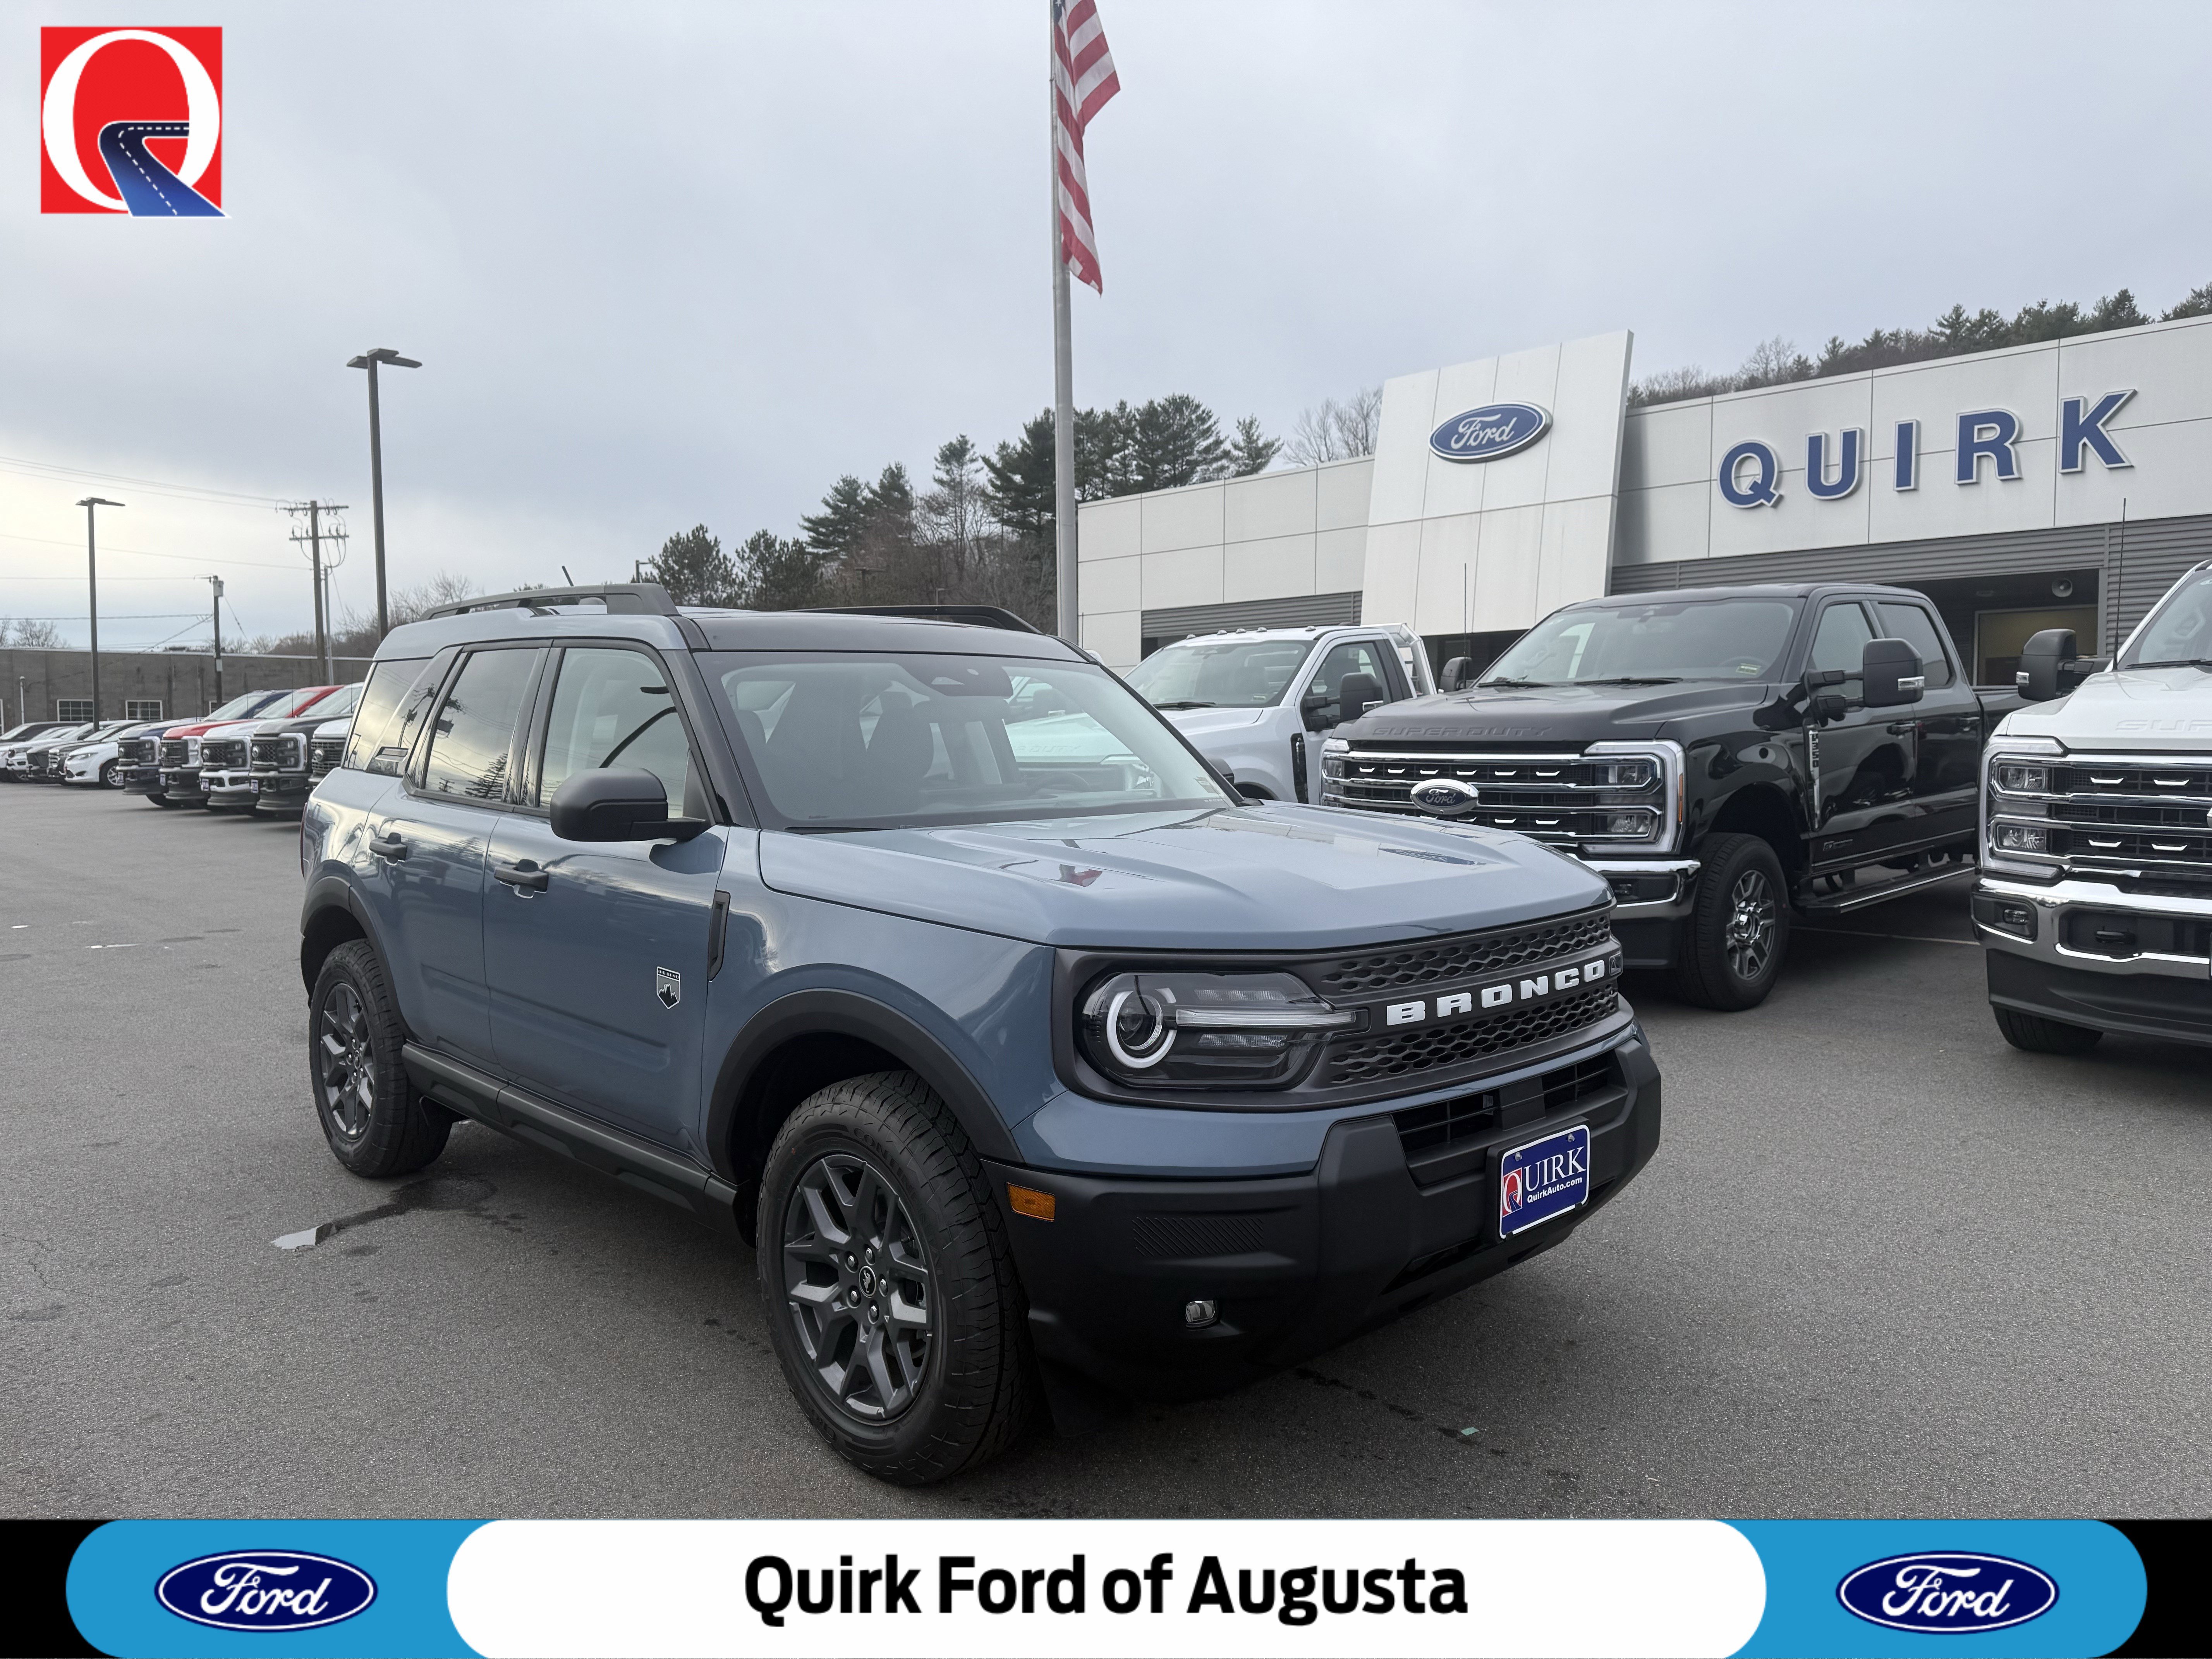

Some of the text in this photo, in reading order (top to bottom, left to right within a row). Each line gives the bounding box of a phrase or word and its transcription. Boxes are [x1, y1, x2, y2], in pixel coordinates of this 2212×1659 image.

[1451, 413, 1518, 450] Ford
[1717, 388, 2137, 508] QUIRK
[1372, 726, 1553, 736] SUPER DUTY
[1426, 788, 1456, 804] Ford
[1387, 960, 1605, 1026] BRONCO
[1503, 1146, 1587, 1213] QUIRK
[1527, 1177, 1583, 1203] QuirkAuto.com
